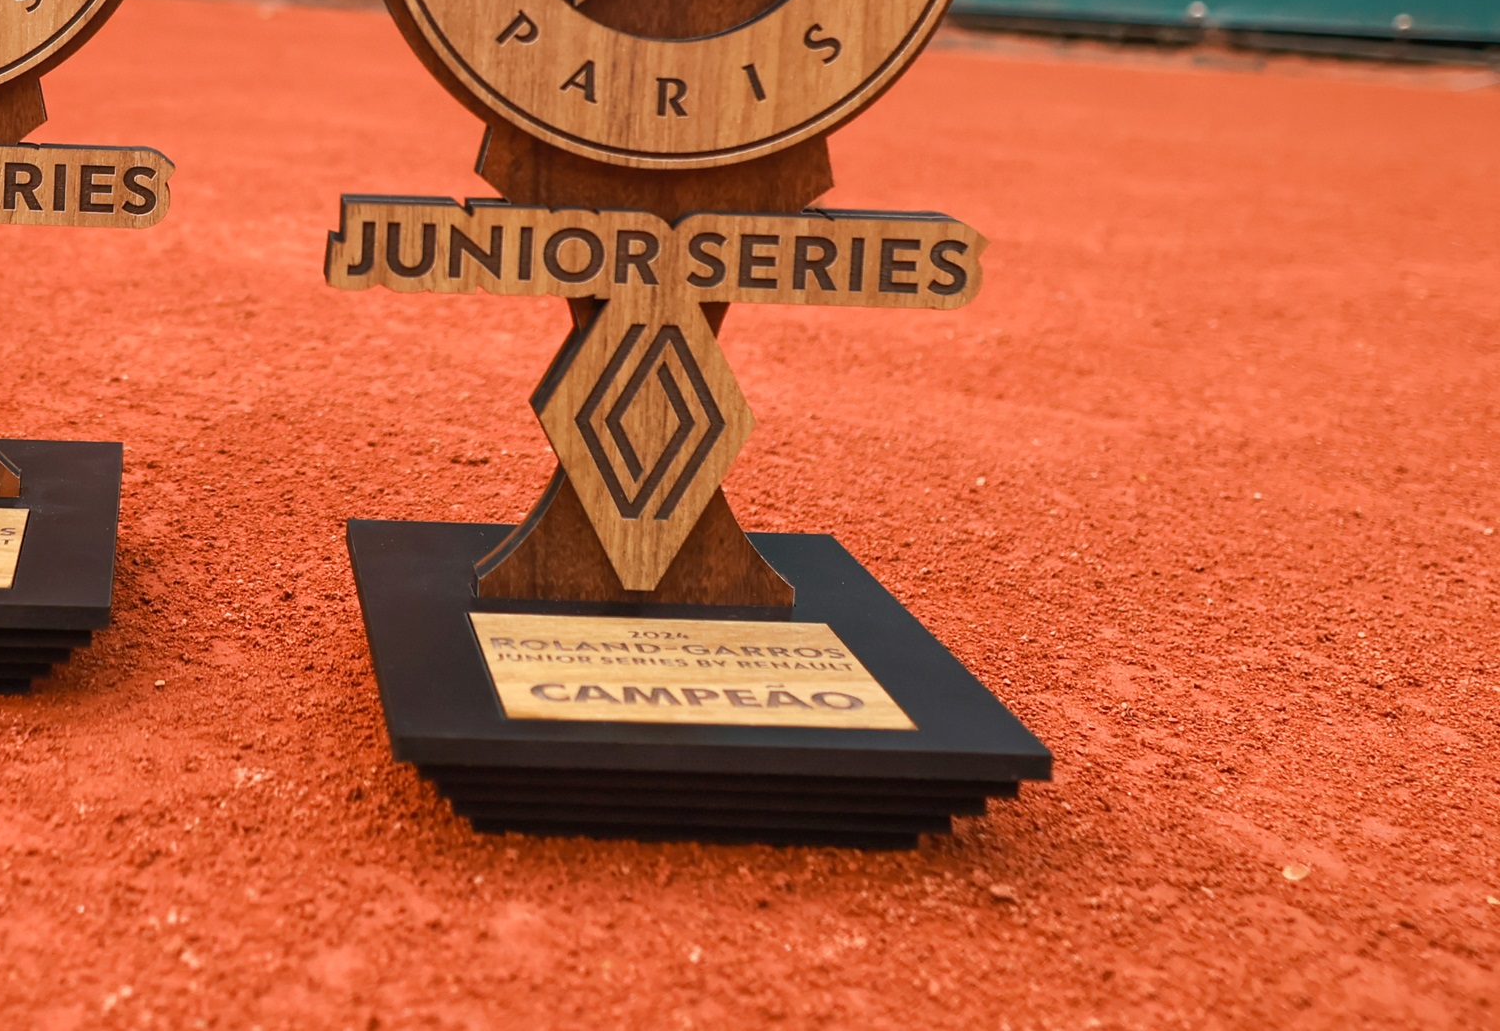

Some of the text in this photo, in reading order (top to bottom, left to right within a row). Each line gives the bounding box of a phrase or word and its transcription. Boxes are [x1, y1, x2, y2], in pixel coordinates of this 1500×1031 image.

[495, 9, 842, 117] PARIS
[347, 220, 969, 296] JUNIOR SERIES
[627, 630, 690, 640] 2024
[490, 637, 846, 659] ROLAND-GARROS
[496, 653, 853, 672] JUNIOR SERIES BY RENAULT
[530, 683, 865, 712] CAMPEÃO
